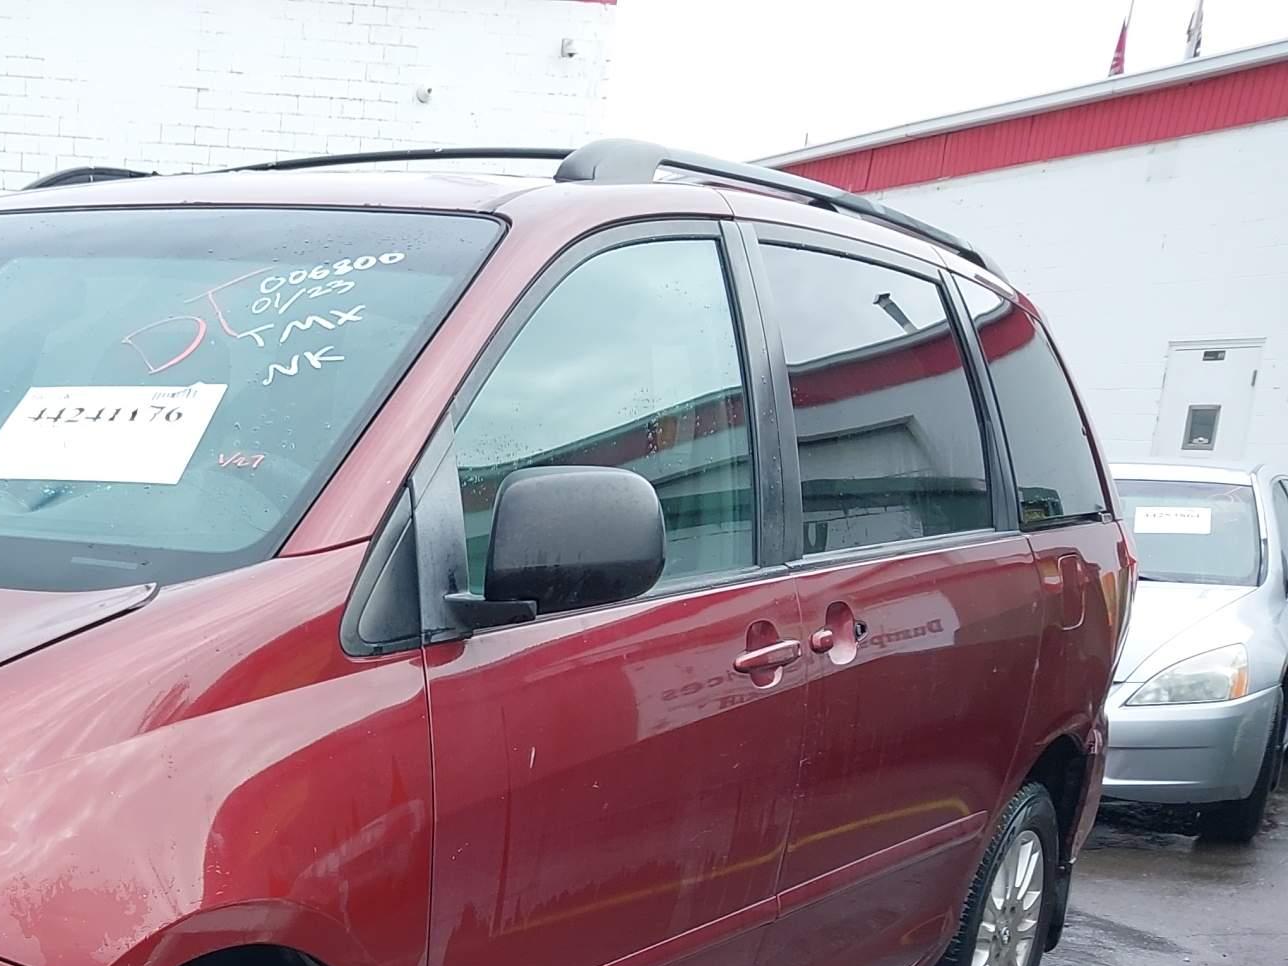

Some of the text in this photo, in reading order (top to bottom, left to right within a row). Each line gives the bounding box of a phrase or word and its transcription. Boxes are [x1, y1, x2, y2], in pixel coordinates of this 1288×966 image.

[260, 251, 405, 294] 006800
[251, 279, 355, 314] 01/23
[236, 303, 366, 347] TMX
[262, 345, 345, 386] NK
[28, 404, 184, 423] 44241176
